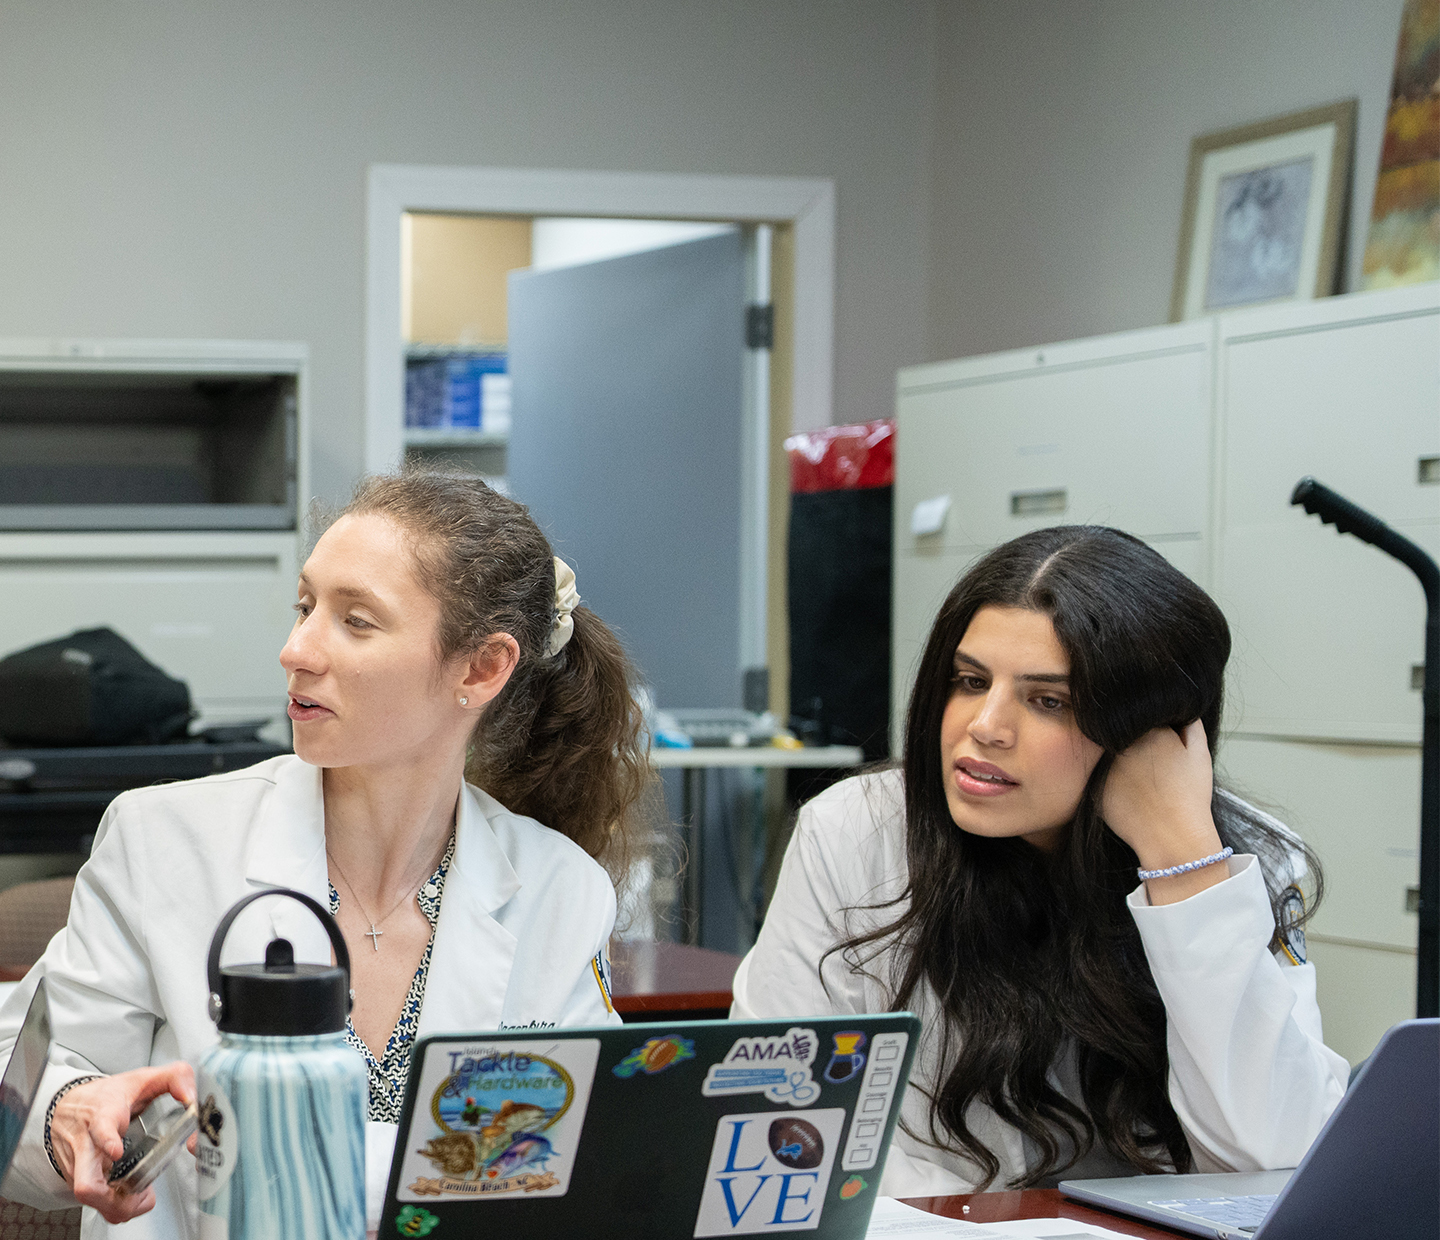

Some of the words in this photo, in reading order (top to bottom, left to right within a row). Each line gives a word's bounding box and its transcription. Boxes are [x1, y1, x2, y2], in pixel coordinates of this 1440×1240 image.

[447, 1050, 531, 1074] Tackle
[730, 1042, 792, 1062] AMA
[467, 1074, 563, 1092] Hardware
